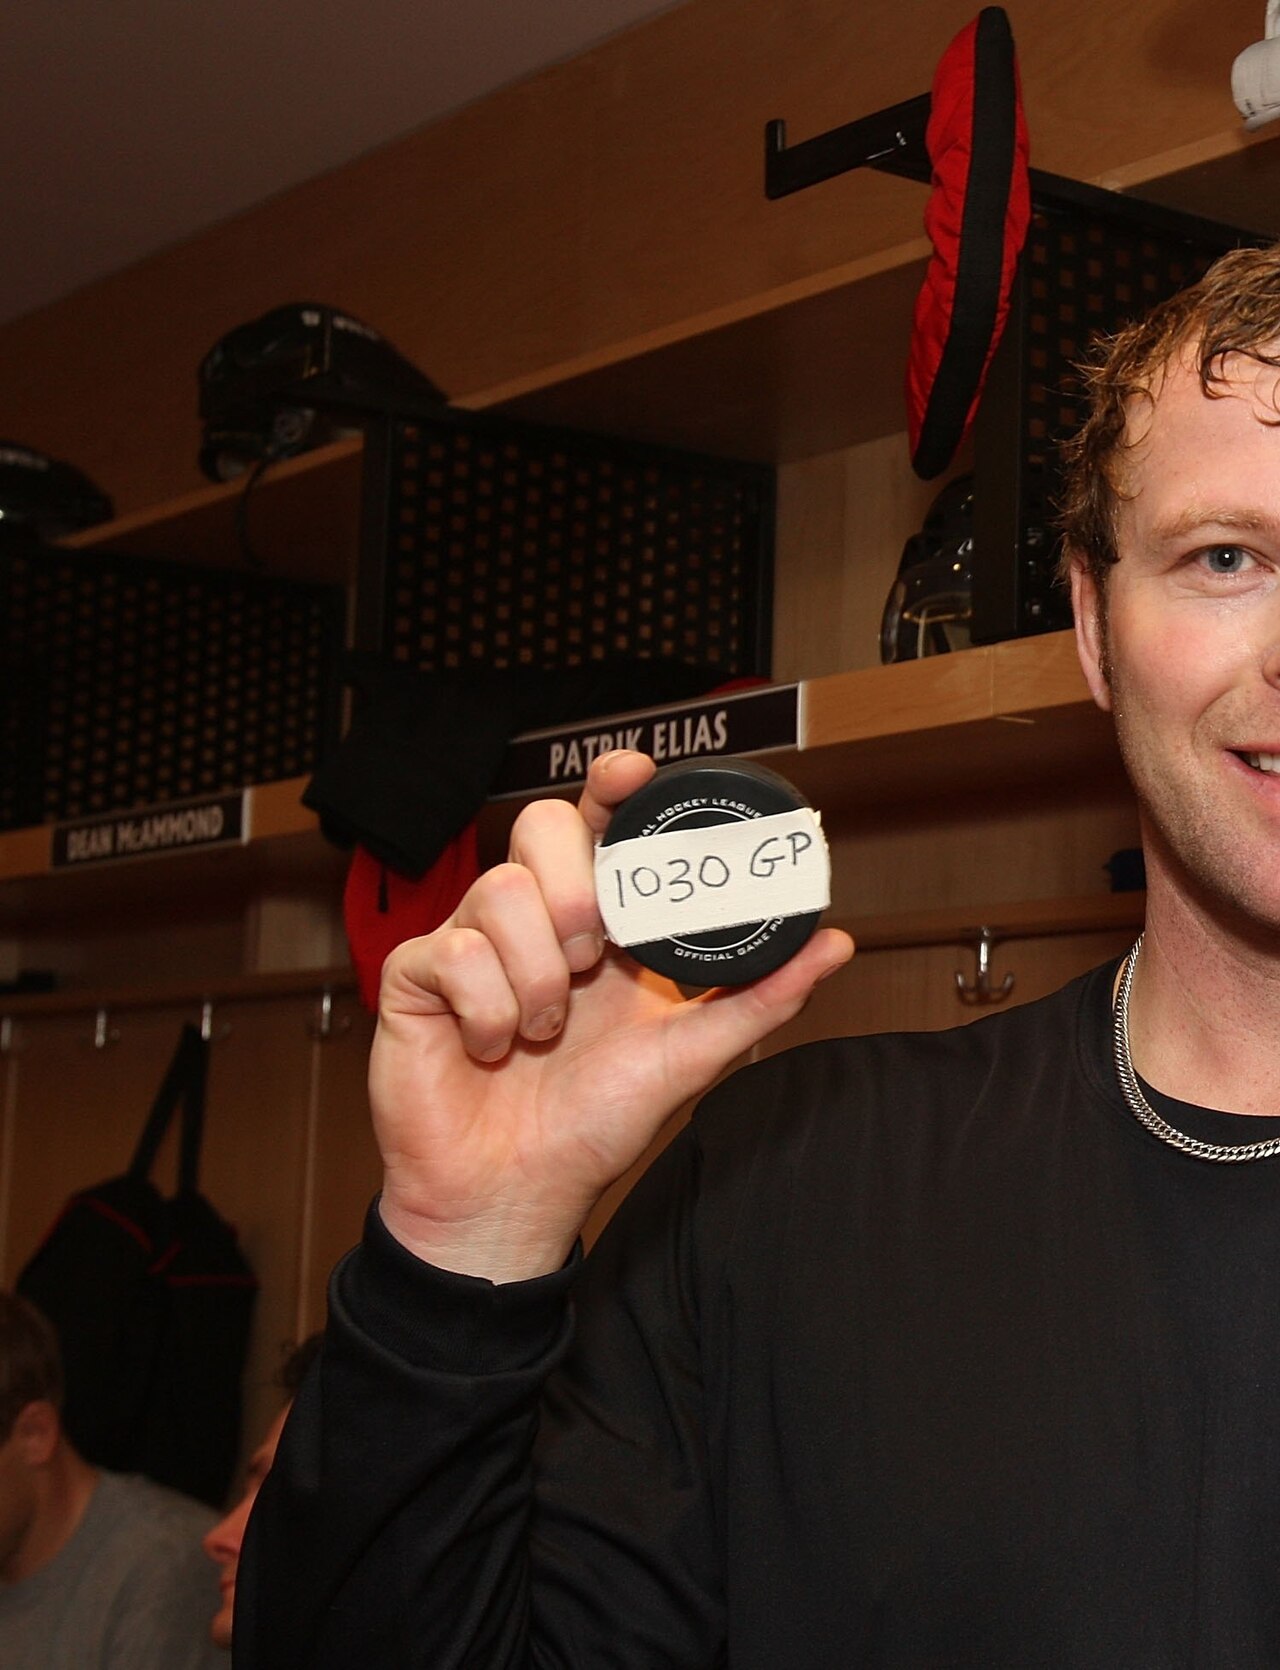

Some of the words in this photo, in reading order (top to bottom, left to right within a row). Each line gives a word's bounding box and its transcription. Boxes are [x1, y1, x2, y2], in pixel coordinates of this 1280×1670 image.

[653, 711, 728, 760] ELIAS
[656, 798, 708, 822] HOCKEY
[67, 826, 113, 861] DEAN
[615, 855, 730, 908] 1030
[749, 831, 812, 878] GP
[674, 947, 734, 962] OFFICIAL
[736, 932, 772, 956] GAME
